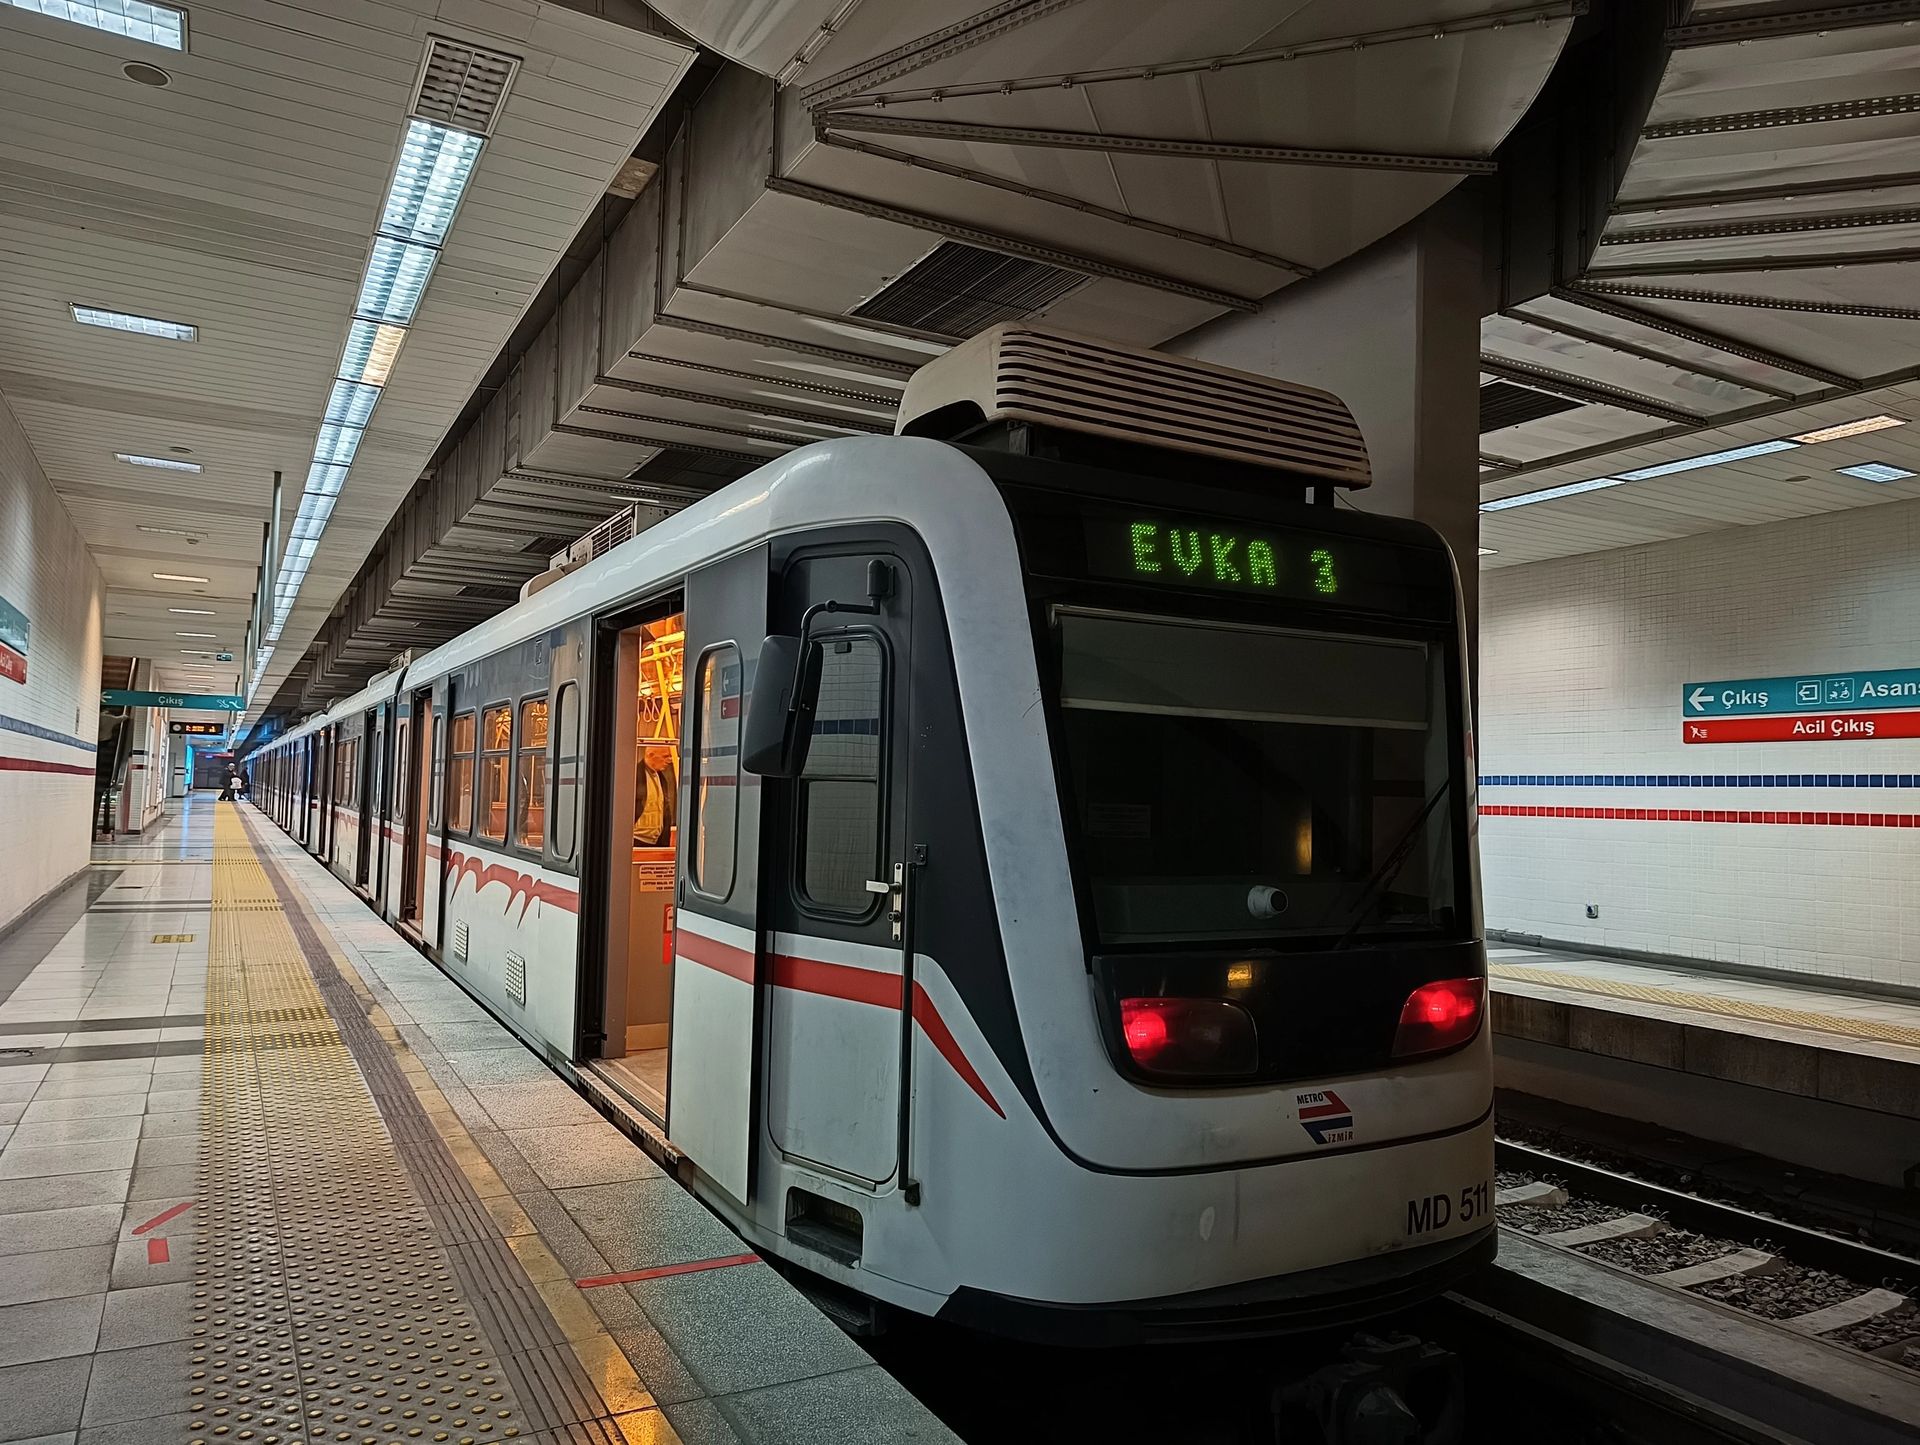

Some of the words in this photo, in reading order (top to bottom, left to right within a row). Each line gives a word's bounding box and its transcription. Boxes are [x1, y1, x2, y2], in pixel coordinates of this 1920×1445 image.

[1131, 523, 1277, 586] EVKA
[1310, 549, 1338, 593] 3
[158, 695, 184, 707] Çıkış
[1721, 690, 1769, 709] Çıkış
[1860, 681, 1920, 698] Asan
[1792, 720, 1825, 734] Acil
[1831, 719, 1875, 737] Çıkış
[1296, 1092, 1324, 1105] METRO
[1407, 1194, 1452, 1236] MD
[1460, 1180, 1488, 1222] 511
